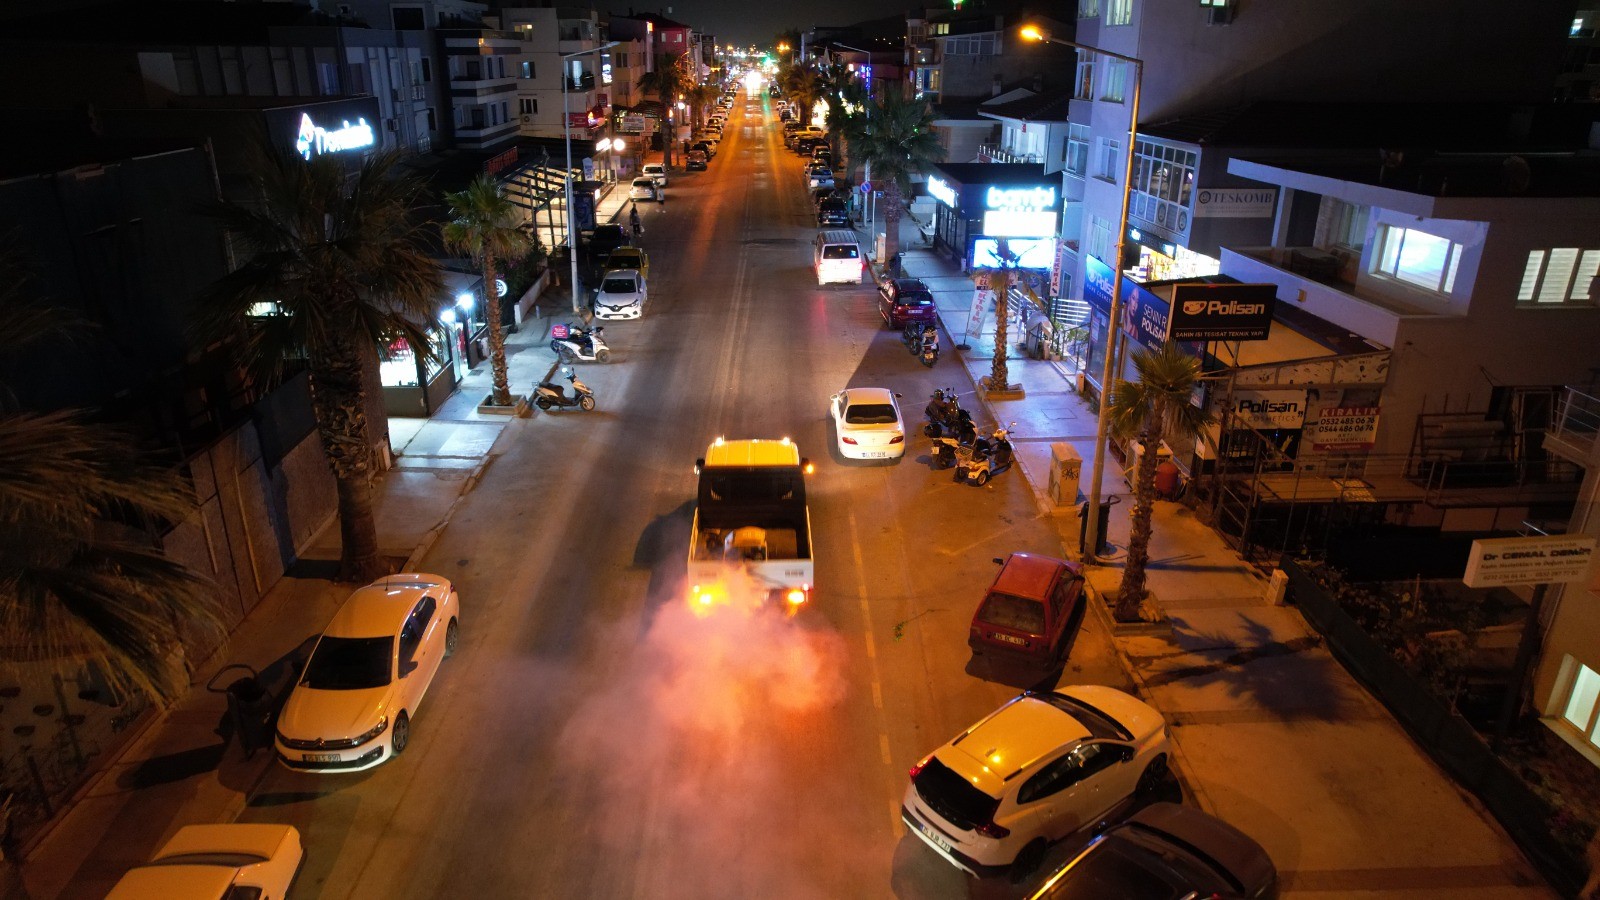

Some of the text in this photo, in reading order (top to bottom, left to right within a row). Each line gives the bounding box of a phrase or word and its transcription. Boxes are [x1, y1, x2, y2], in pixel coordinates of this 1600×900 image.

[986, 186, 1056, 209] bambi
[1213, 192, 1272, 203] TESKOMB
[1207, 300, 1266, 316] Polisan
[1239, 399, 1298, 413] Polisan
[1321, 407, 1379, 417] KIRALIK
[1320, 417, 1339, 425] 0532
[1319, 425, 1338, 433] 0544
[1502, 550, 1547, 560] CEMAL
